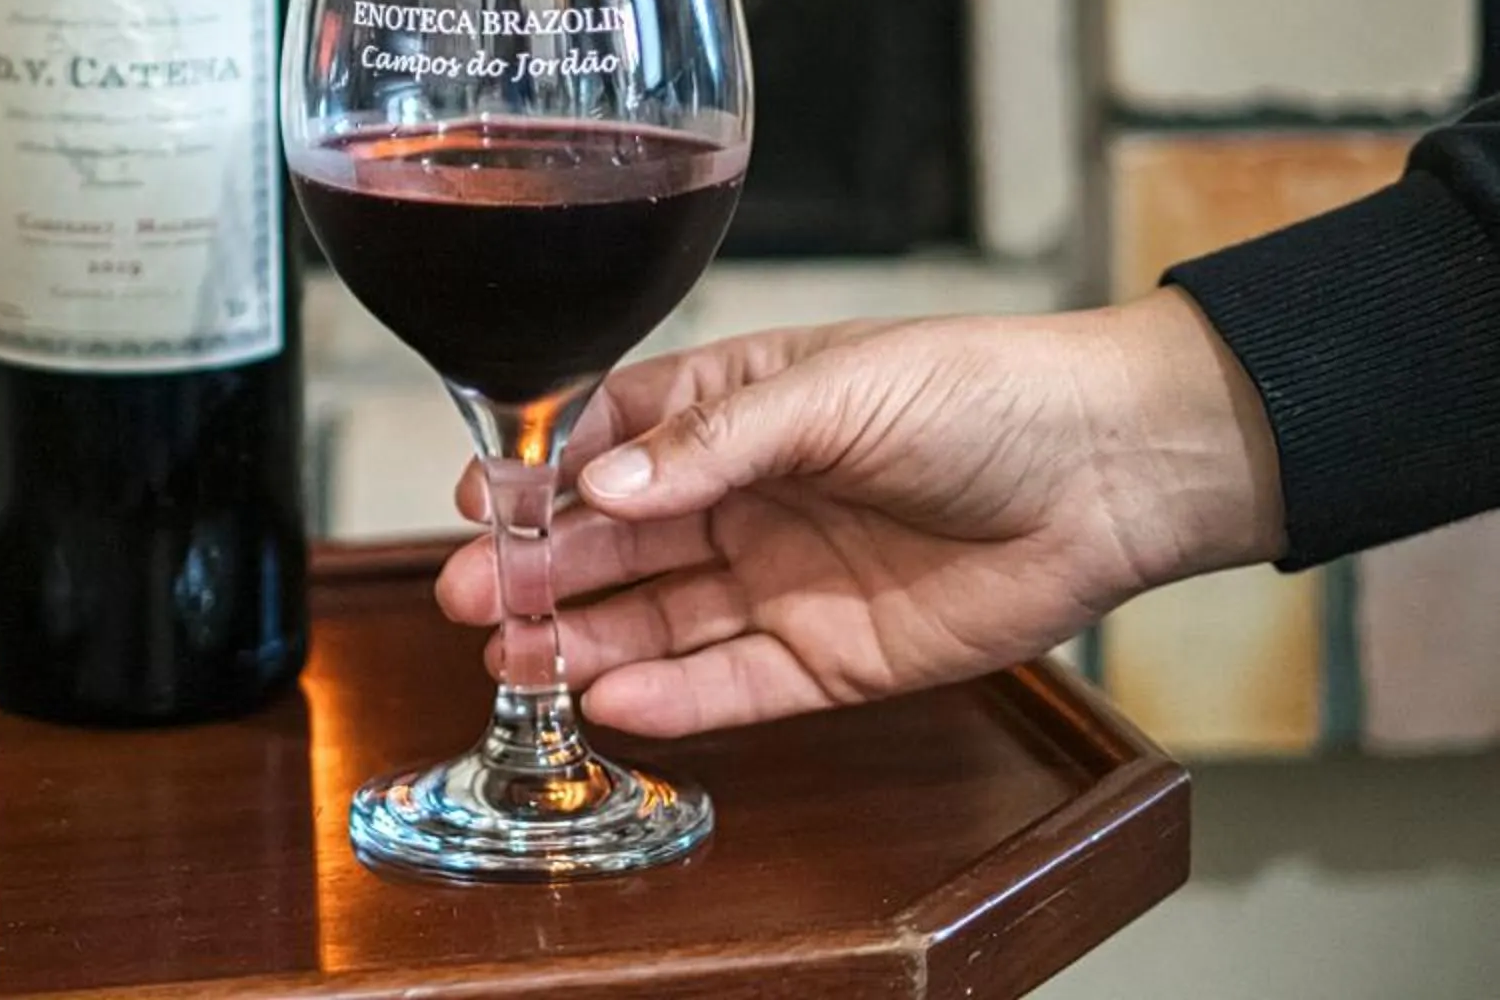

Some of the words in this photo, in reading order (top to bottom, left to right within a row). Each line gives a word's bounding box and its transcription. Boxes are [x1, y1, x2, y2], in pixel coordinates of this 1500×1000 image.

[354, 1, 475, 34] ENOTECA
[482, 6, 628, 35] BRAZOLIN
[361, 45, 461, 81] Campos
[466, 50, 508, 77] do
[511, 49, 620, 82] Jordão
